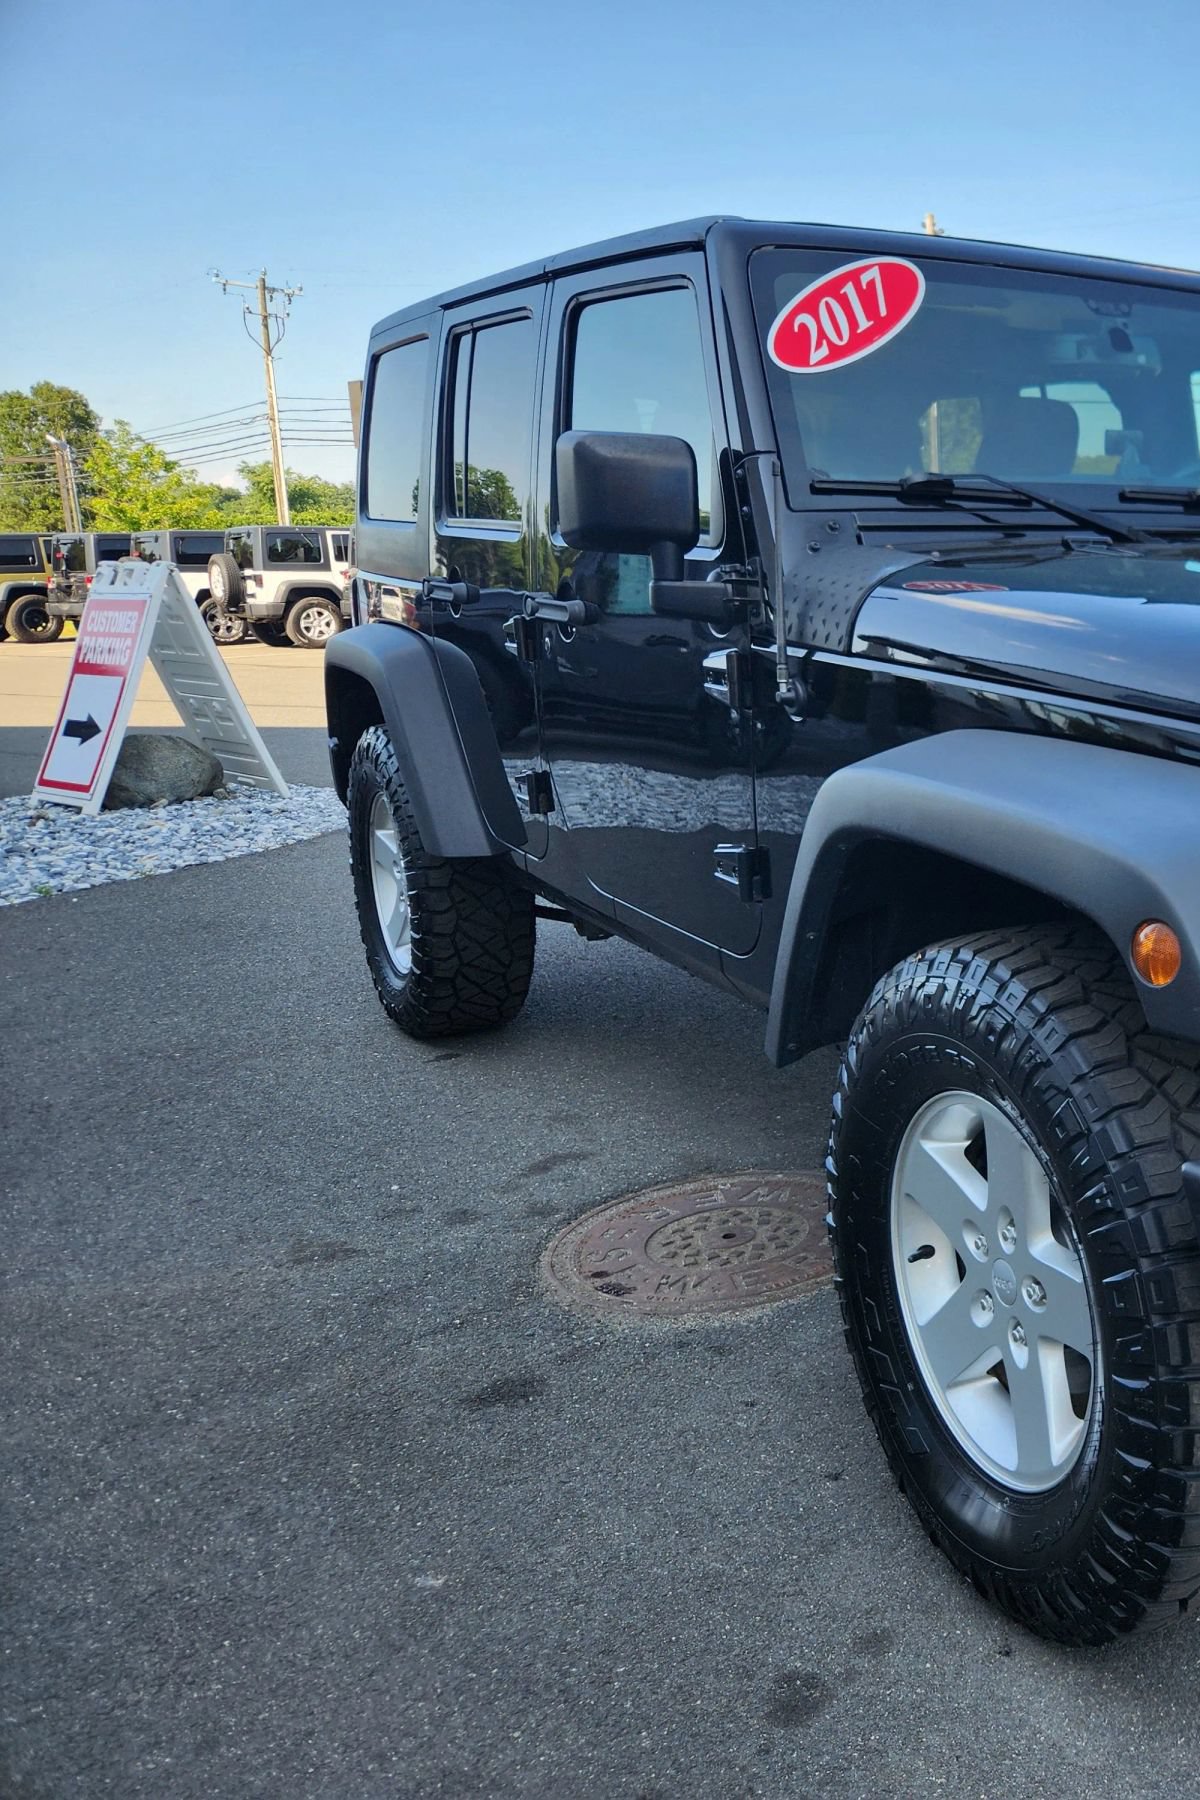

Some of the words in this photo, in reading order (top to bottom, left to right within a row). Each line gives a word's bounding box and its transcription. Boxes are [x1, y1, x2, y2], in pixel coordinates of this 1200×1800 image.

[794, 265, 887, 366] 2017
[87, 610, 139, 633] CUSTOMER
[79, 636, 133, 665] PARKING
